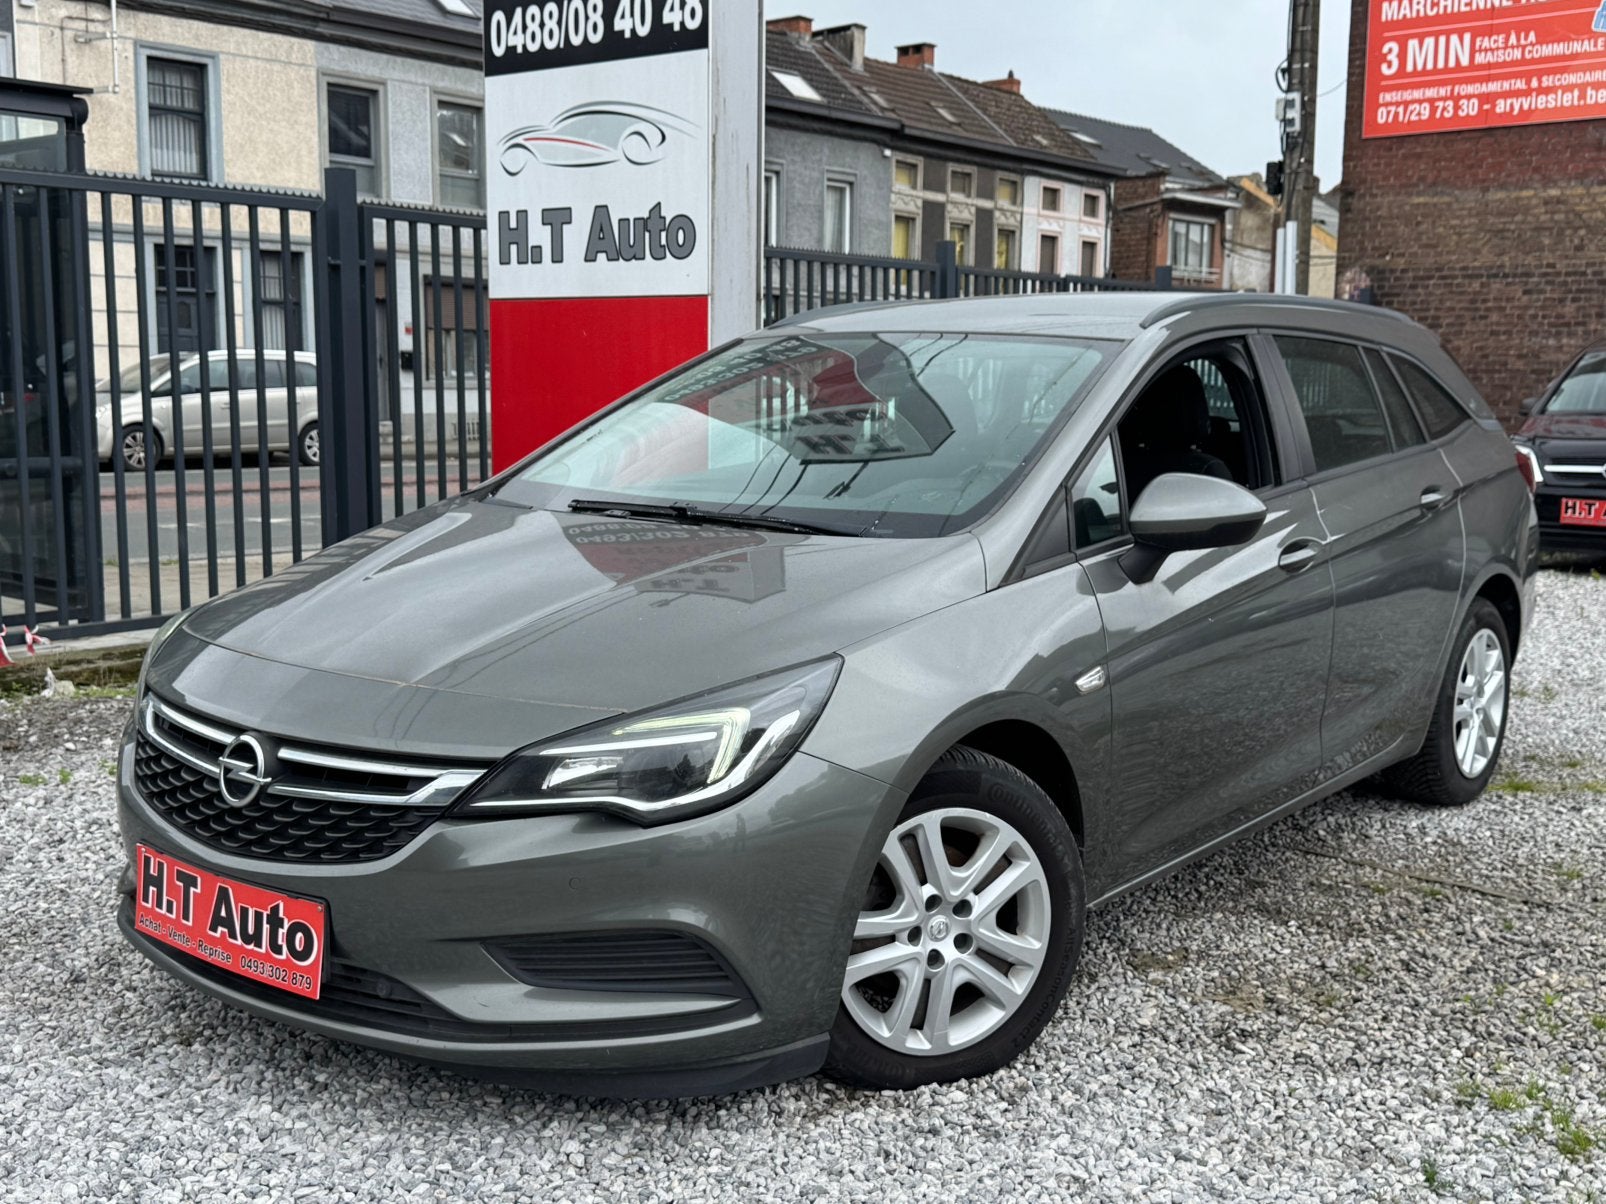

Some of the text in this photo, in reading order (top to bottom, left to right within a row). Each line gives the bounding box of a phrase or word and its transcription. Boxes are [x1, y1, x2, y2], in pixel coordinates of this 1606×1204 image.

[490, 0, 703, 57] 0488/08 40 48
[1381, 0, 1514, 22] MARCHIEN
[1380, 32, 1471, 76] 3 MIN
[1475, 29, 1536, 49] FACE À LA
[1475, 37, 1605, 65] MAISON COMMUNALE
[1377, 103, 1430, 124] 071/29
[1434, 101, 1454, 120] 73
[1458, 98, 1478, 117] 30
[1495, 86, 1606, 115] aryvieslet.be
[1378, 85, 1452, 104] ENSEIGNEMENT
[1453, 77, 1528, 97] FONDAMENTAL
[1530, 76, 1539, 89] &
[498, 201, 697, 265] H.T Auto
[1564, 501, 1598, 518] H.T
[140, 852, 318, 966] H.T Auto
[139, 912, 161, 934] Achat
[168, 925, 191, 947] Vente
[197, 939, 233, 964] Reprise
[291, 971, 313, 990] 879
